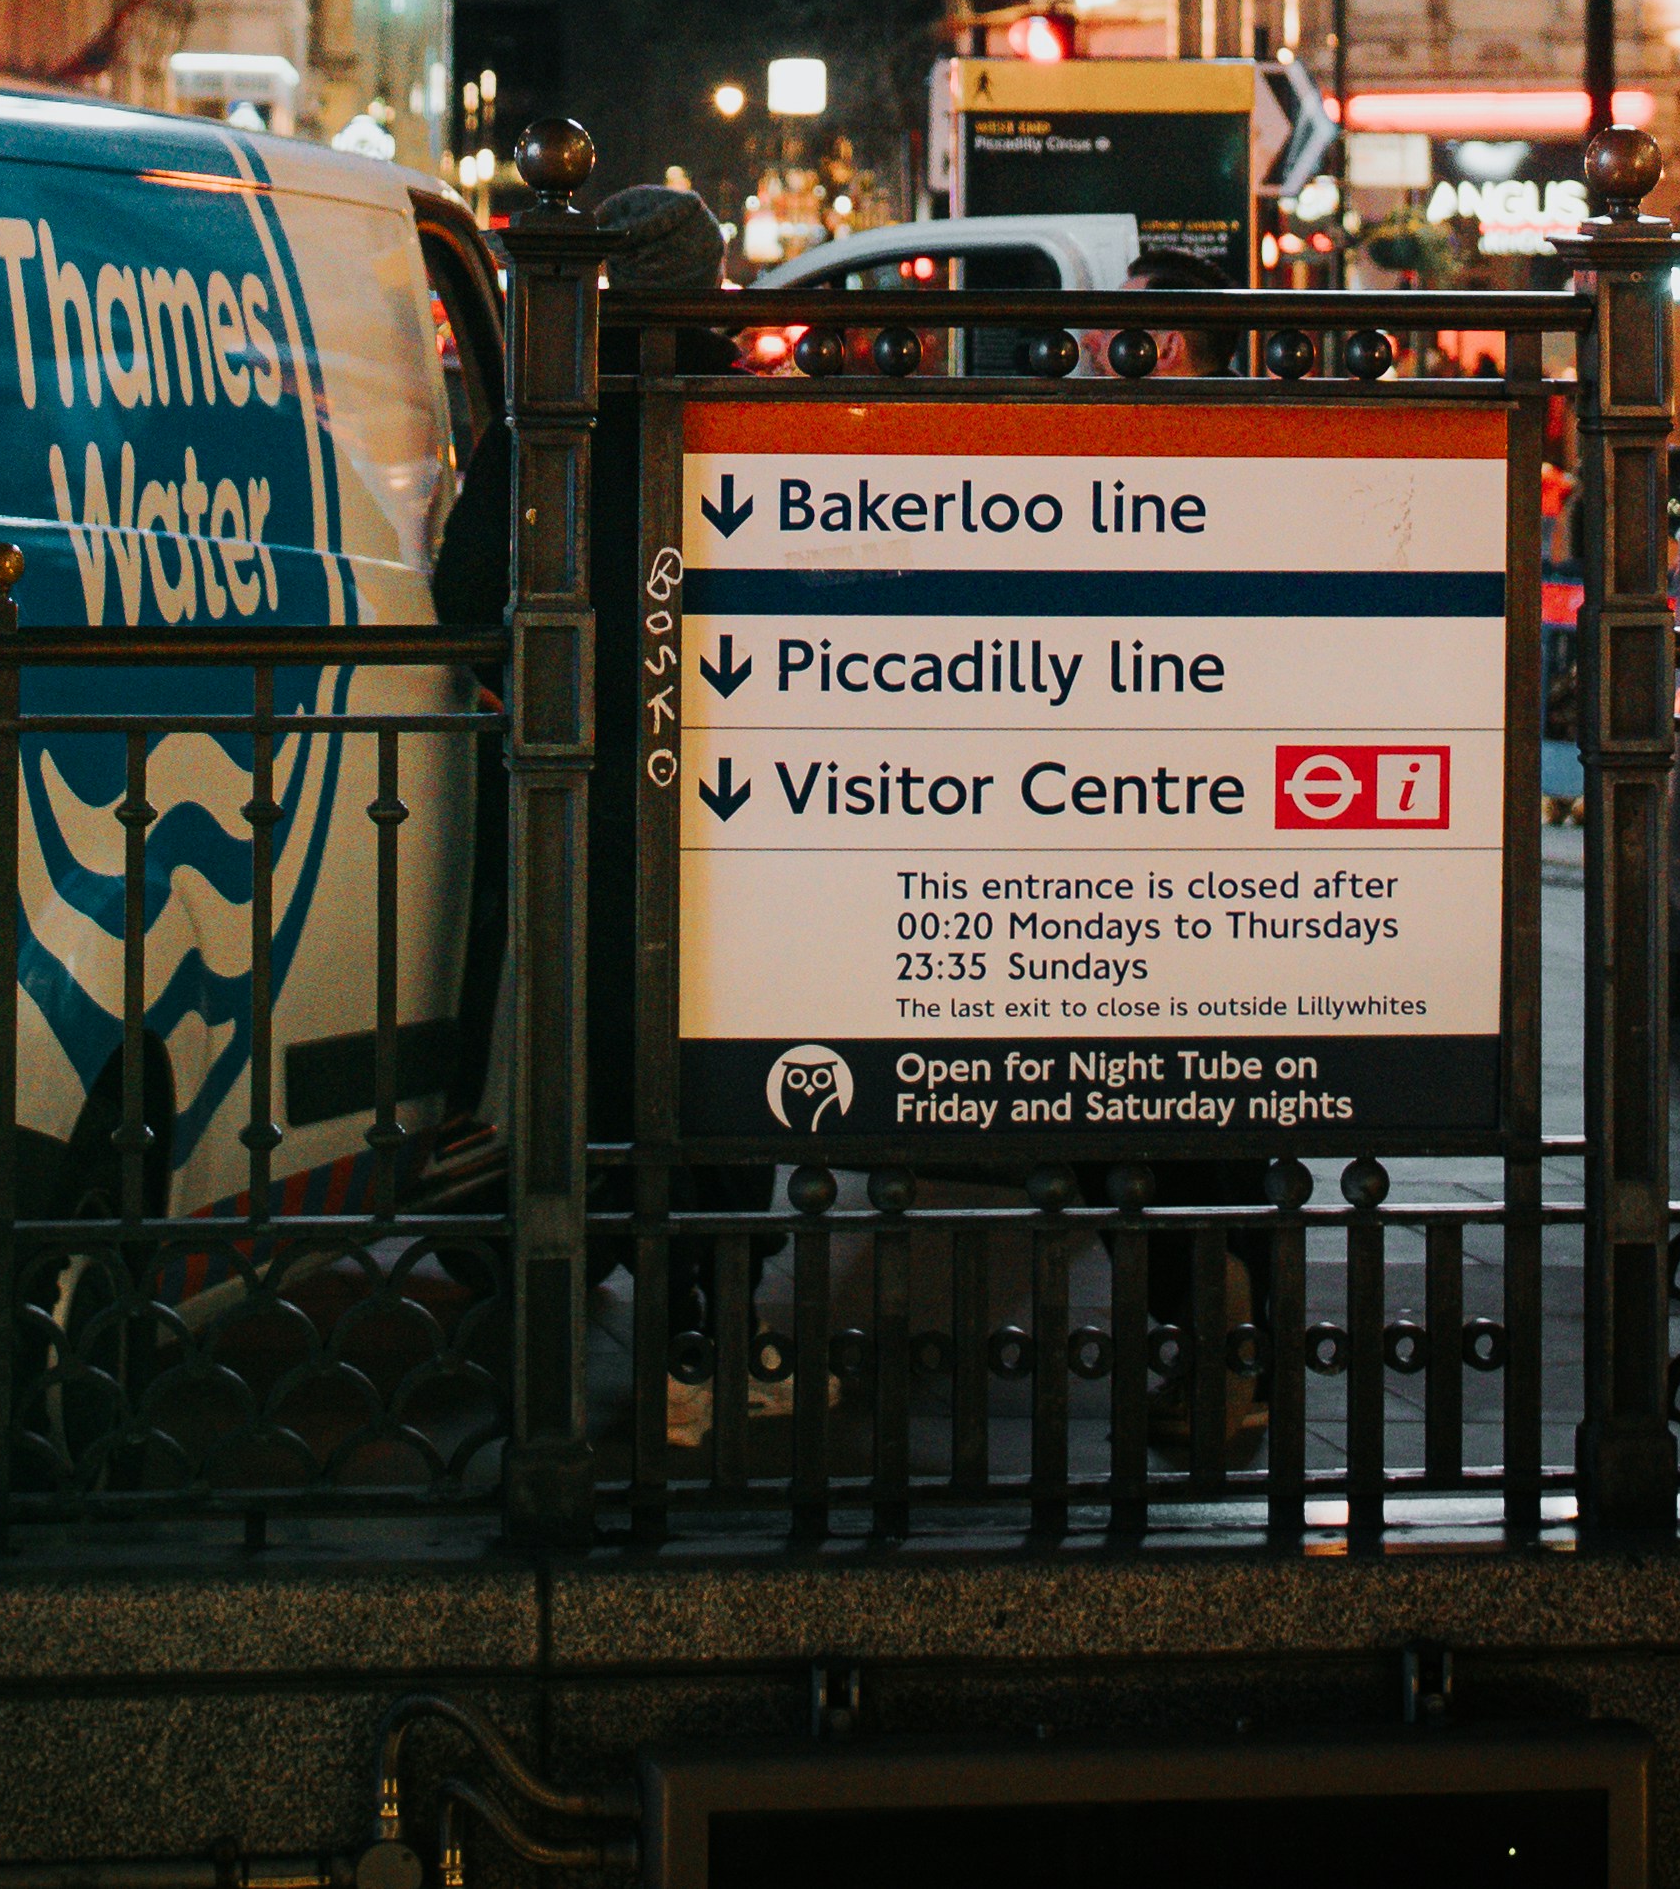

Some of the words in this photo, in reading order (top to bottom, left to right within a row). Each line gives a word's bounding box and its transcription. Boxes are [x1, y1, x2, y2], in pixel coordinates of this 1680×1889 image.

[1426, 180, 1590, 225] ANGUS
[780, 479, 1063, 533] Bakerloo
[1092, 481, 1206, 533] line
[48, 442, 278, 624] Water
[779, 639, 1082, 706] Piccadilly
[1111, 640, 1224, 693] line
[775, 762, 993, 815] Visitor
[1021, 762, 1244, 815] Centre
[897, 872, 968, 899] This
[982, 875, 1133, 900] entrance
[1149, 872, 1173, 899] is
[1188, 871, 1299, 899] closed
[1314, 870, 1398, 899] after
[898, 912, 993, 940] 00:20
[1010, 912, 1160, 946] Mondays
[1175, 915, 1212, 939] to
[1226, 911, 1398, 945] Thursdays
[897, 952, 986, 980] 23:35
[1009, 952, 1148, 985] Sundays
[896, 998, 940, 1018] The
[951, 999, 994, 1018] last
[1005, 1000, 1050, 1017] exit
[1061, 1000, 1087, 1017] to
[1097, 998, 1160, 1017] close
[1170, 997, 1188, 1017] is
[1198, 996, 1287, 1016] outside
[1298, 996, 1427, 1020] Lillywhites
[896, 1053, 991, 1089] Open
[1004, 1051, 1055, 1081] for
[1070, 1051, 1164, 1087] Night
[1178, 1051, 1262, 1080] Tube
[1275, 1057, 1317, 1079] on
[897, 1093, 998, 1129] Friday
[1011, 1092, 1071, 1121] and
[1086, 1091, 1235, 1126] Saturday
[1249, 1090, 1353, 1126] nights
